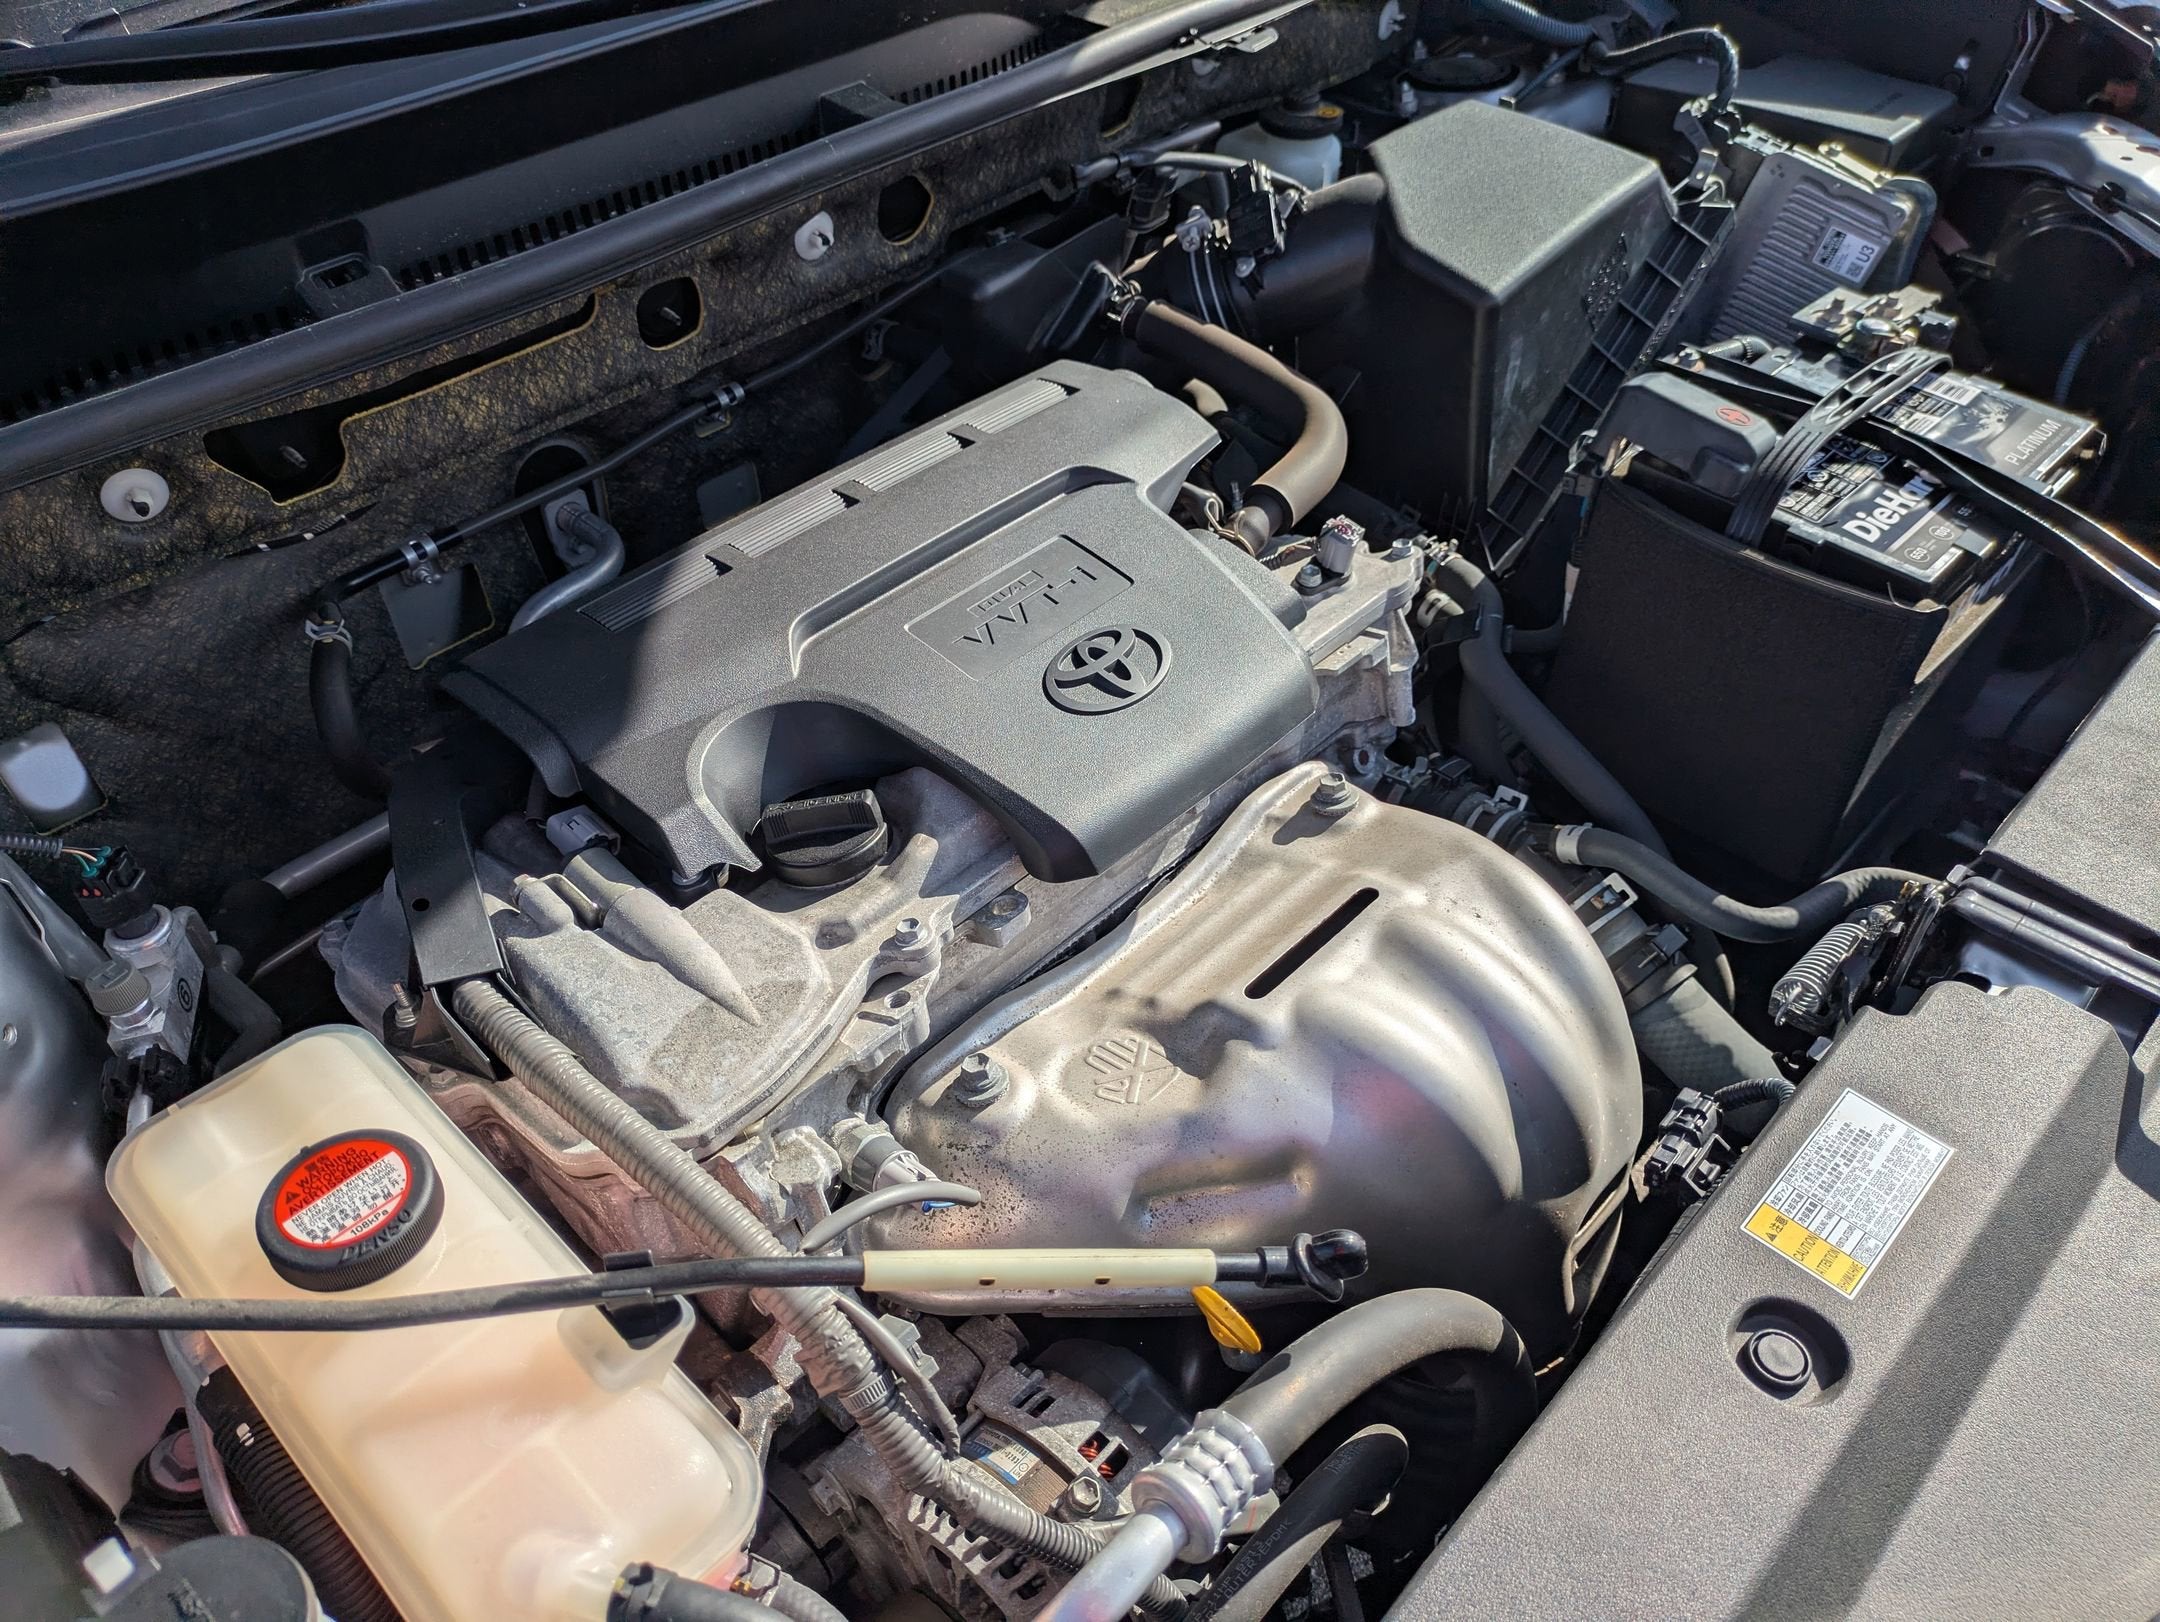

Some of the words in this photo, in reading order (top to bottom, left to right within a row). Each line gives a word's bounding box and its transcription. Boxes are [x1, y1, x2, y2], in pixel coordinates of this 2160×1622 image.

[1857, 245, 1875, 263] U3
[2004, 418, 2061, 466] PLATINUM
[1841, 476, 1935, 543] DieHar
[289, 1151, 378, 1215] AVERTISSEMENT
[296, 1147, 356, 1188] WARNING
[302, 1149, 368, 1194] ОСТОРОЖНО
[1824, 1199, 1833, 1207] TO
[1830, 1186, 1842, 1200] AVOID
[1840, 1166, 1859, 1186] PERSONAL
[1867, 1137, 1877, 1149] KEEP
[1875, 1122, 1889, 1138] HANDS
[1831, 1198, 1841, 1211] AWAY
[1839, 1185, 1851, 1198] FROM
[1858, 1161, 1869, 1173] FANS
[1866, 1152, 1876, 1161] MAY
[1873, 1138, 1885, 1152] START
[1888, 1123, 1896, 1133] ANY
[291, 1203, 319, 1224] NEVER
[320, 1187, 343, 1204] OPEN
[343, 1170, 368, 1188] WHEN
[369, 1158, 389, 1172] HOT.
[295, 1219, 306, 1229] NE
[308, 1201, 333, 1221] JAMAIS
[333, 1183, 361, 1203] OUVRIR
[1836, 1202, 1848, 1214] TIME
[1845, 1182, 1862, 1203] IGNITION
[299, 1224, 310, 1234] НЕ
[309, 1200, 348, 1226] ОТКРЫВАТЬ
[341, 1209, 412, 1262] DENSO
[350, 1209, 389, 1235] 108kPa
[1769, 1215, 1788, 1233] 注意
[1813, 1219, 1829, 1235] COOLING
[1793, 1233, 1818, 1261] CAUTION
[1815, 1247, 1840, 1275] ATTENTION
[1837, 1261, 1863, 1291] ВНИМАНИЕ
